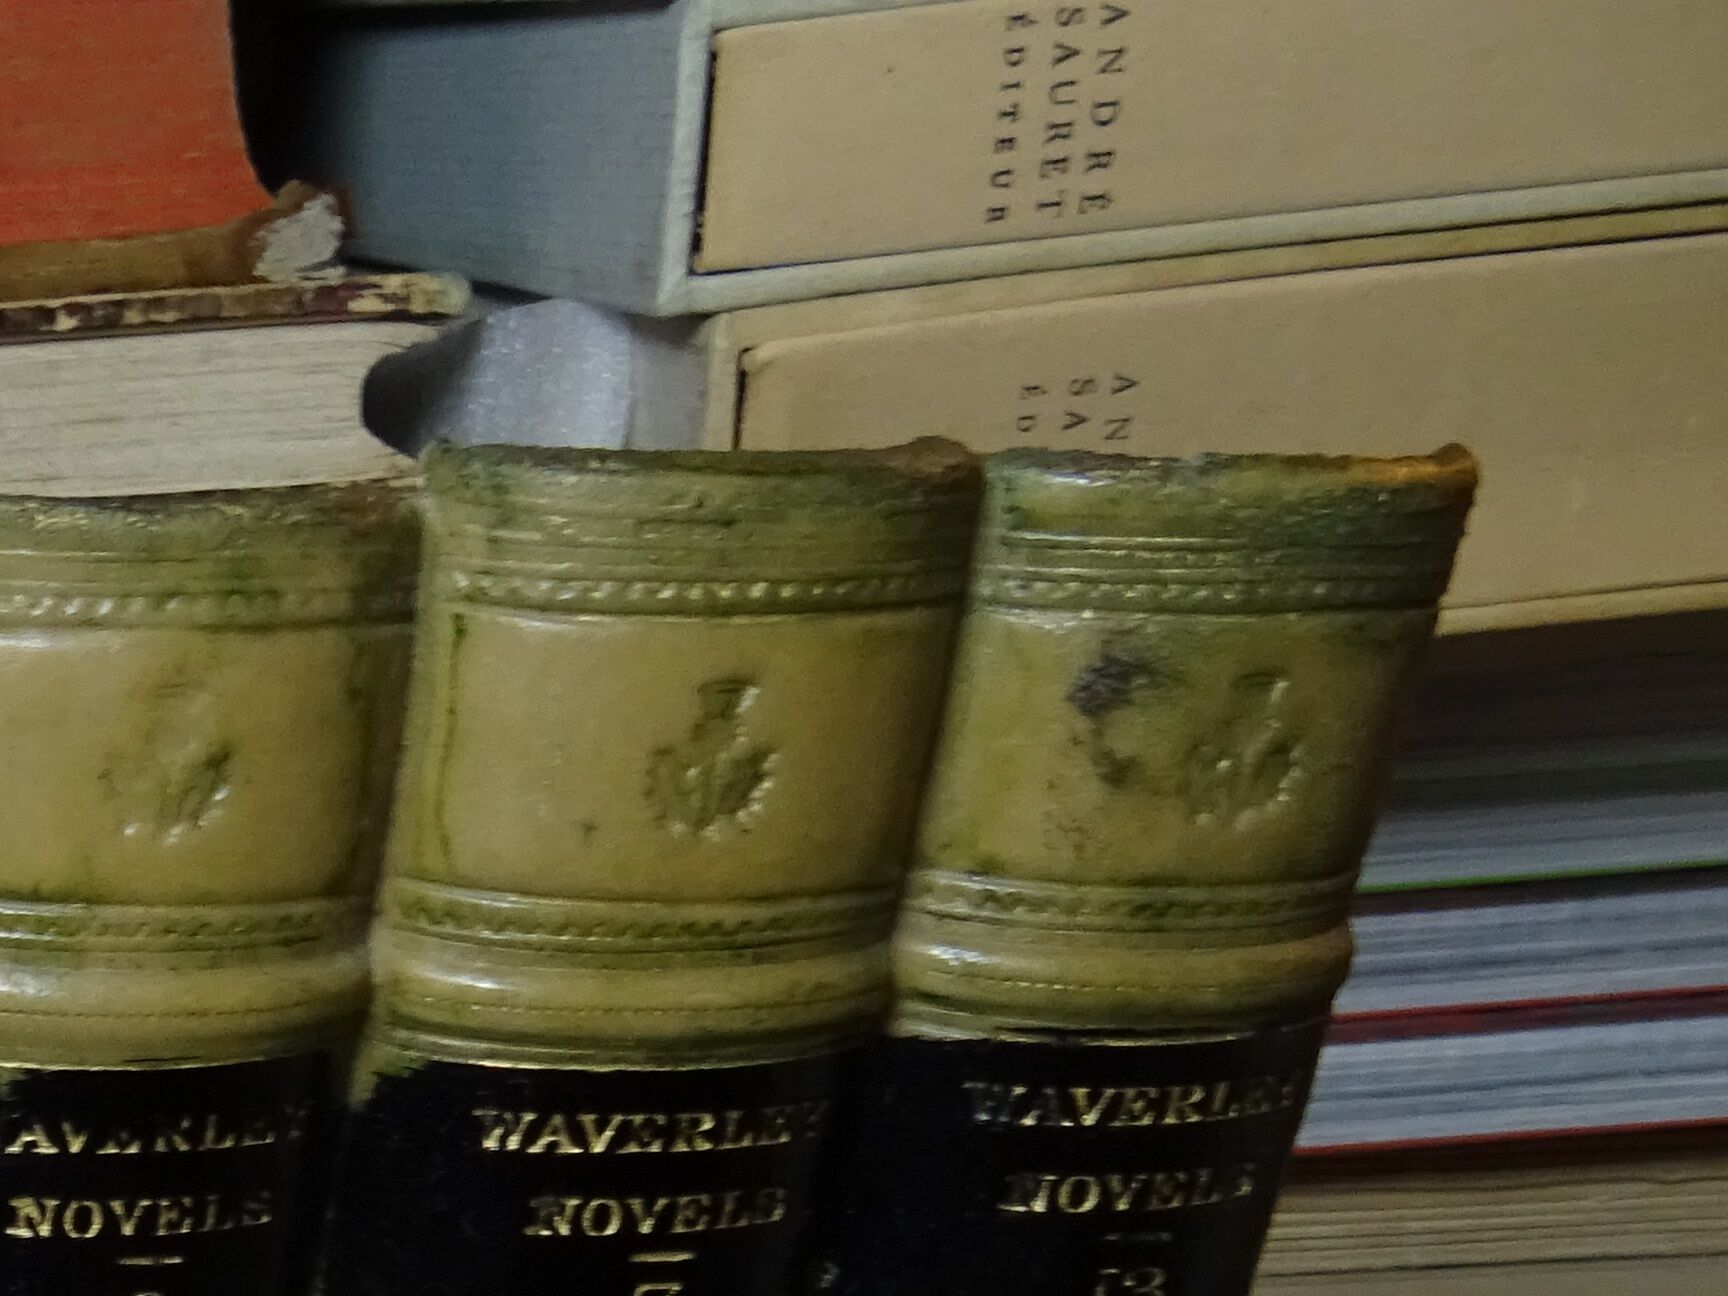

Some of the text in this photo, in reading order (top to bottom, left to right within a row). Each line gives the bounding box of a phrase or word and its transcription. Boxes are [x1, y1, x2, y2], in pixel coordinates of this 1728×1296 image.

[1034, 6, 1089, 220] SAURET
[4, 1192, 273, 1239] NOVELS
[522, 1188, 787, 1237] NOVELS
